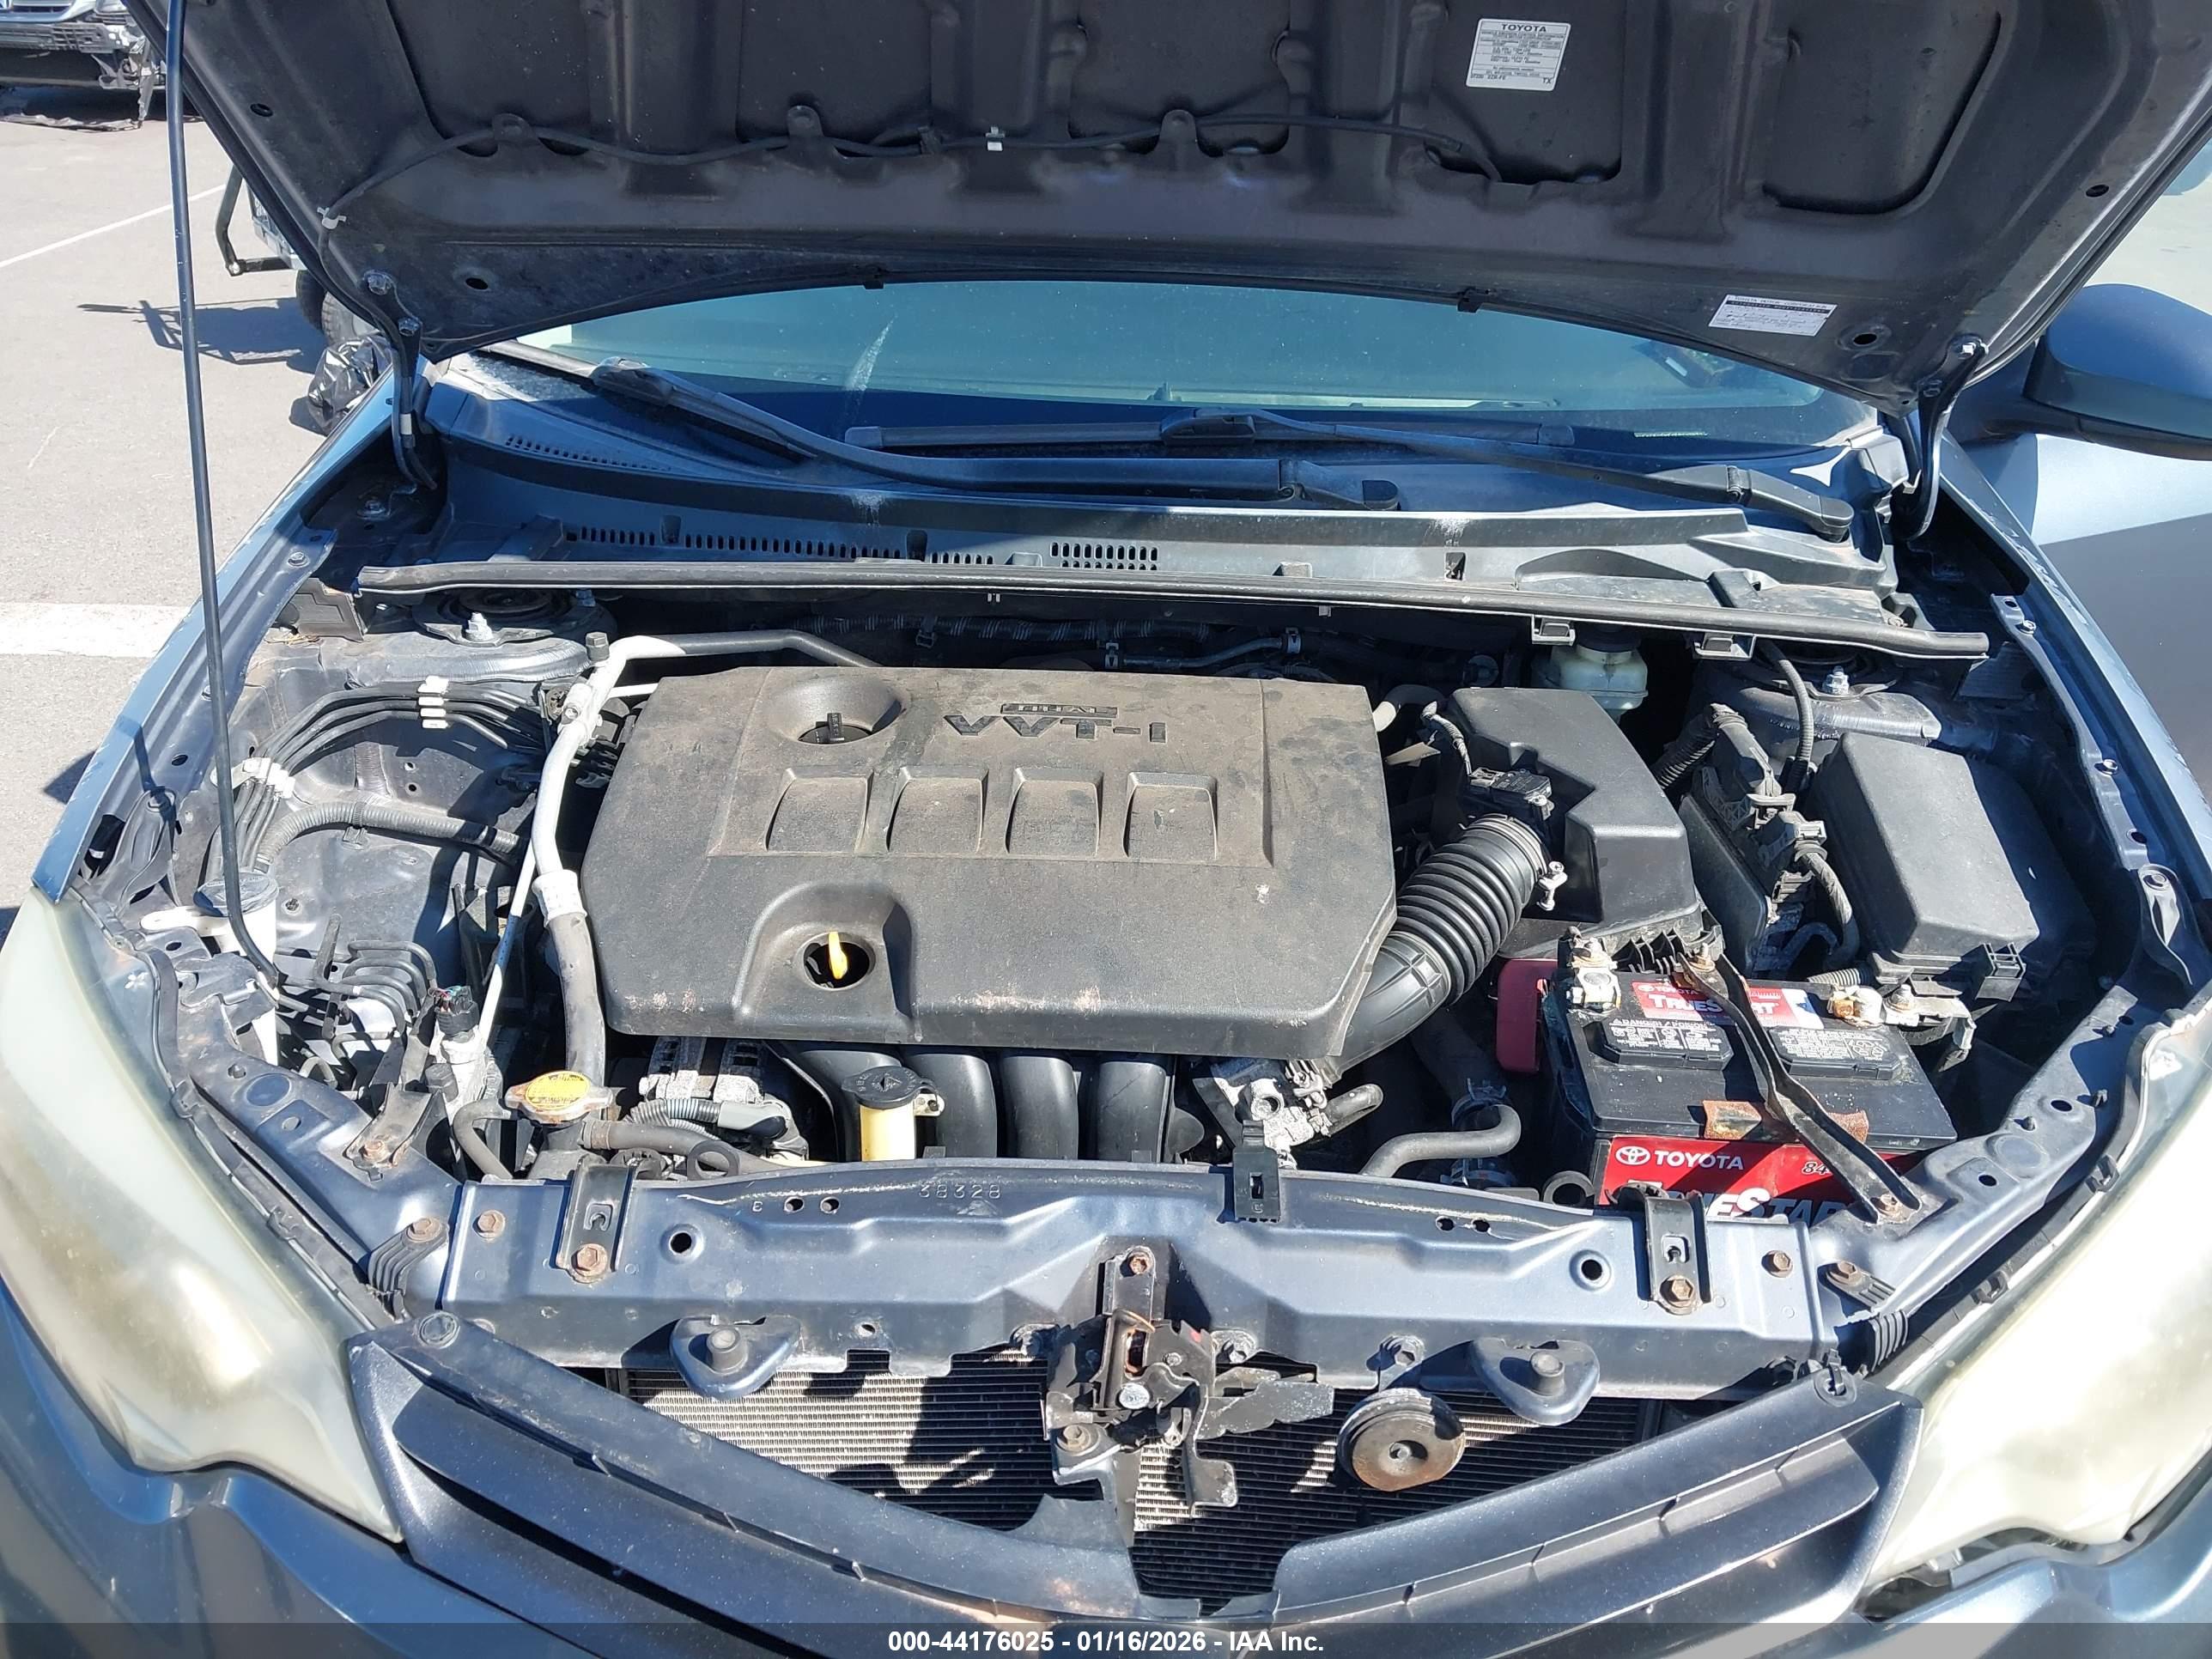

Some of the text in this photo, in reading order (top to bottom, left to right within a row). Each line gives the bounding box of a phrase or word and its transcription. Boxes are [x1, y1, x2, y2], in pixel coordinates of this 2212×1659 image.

[1501, 24, 1547, 33] TOYOTA
[1000, 703, 1118, 719] DUAL
[1654, 1150, 1744, 1170] TOYOTA
[919, 1185, 1000, 1199] 38328
